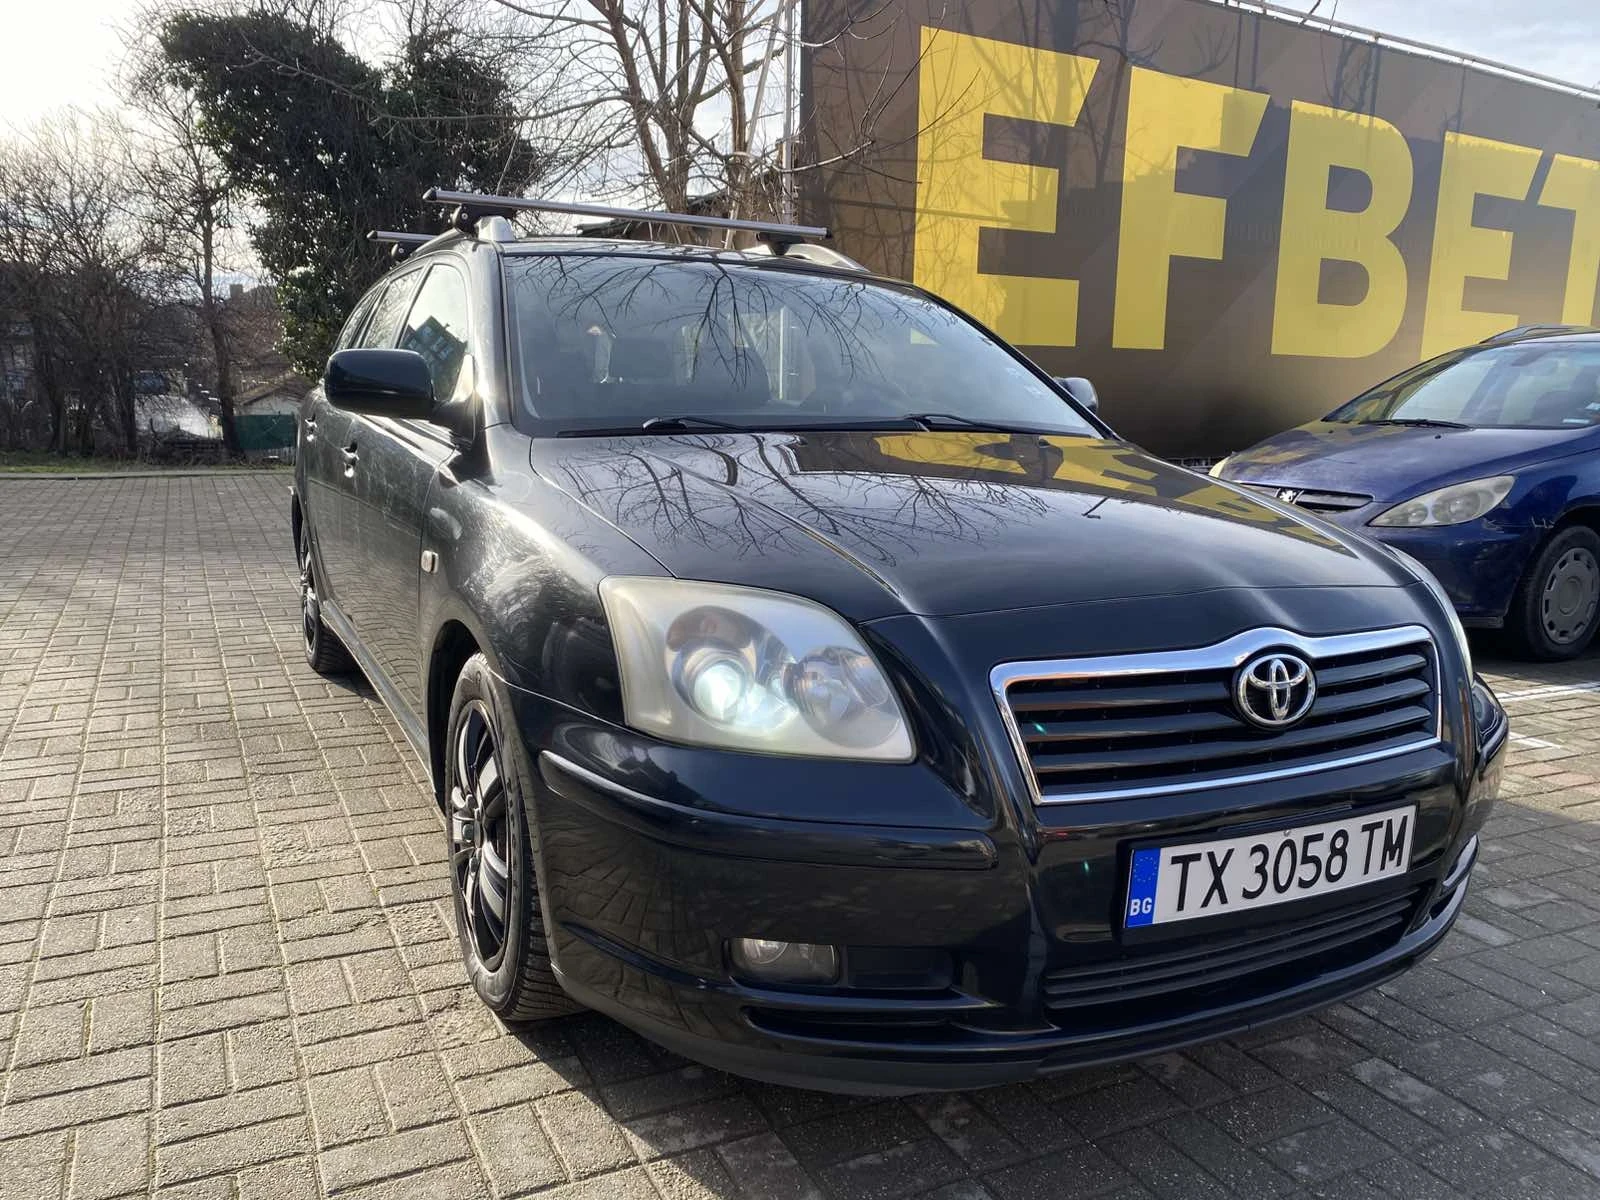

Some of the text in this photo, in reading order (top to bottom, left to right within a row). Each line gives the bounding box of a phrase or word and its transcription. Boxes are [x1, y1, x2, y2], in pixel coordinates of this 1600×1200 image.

[1171, 815, 1408, 911] TX 3058 TM
[1130, 898, 1153, 916] BG
